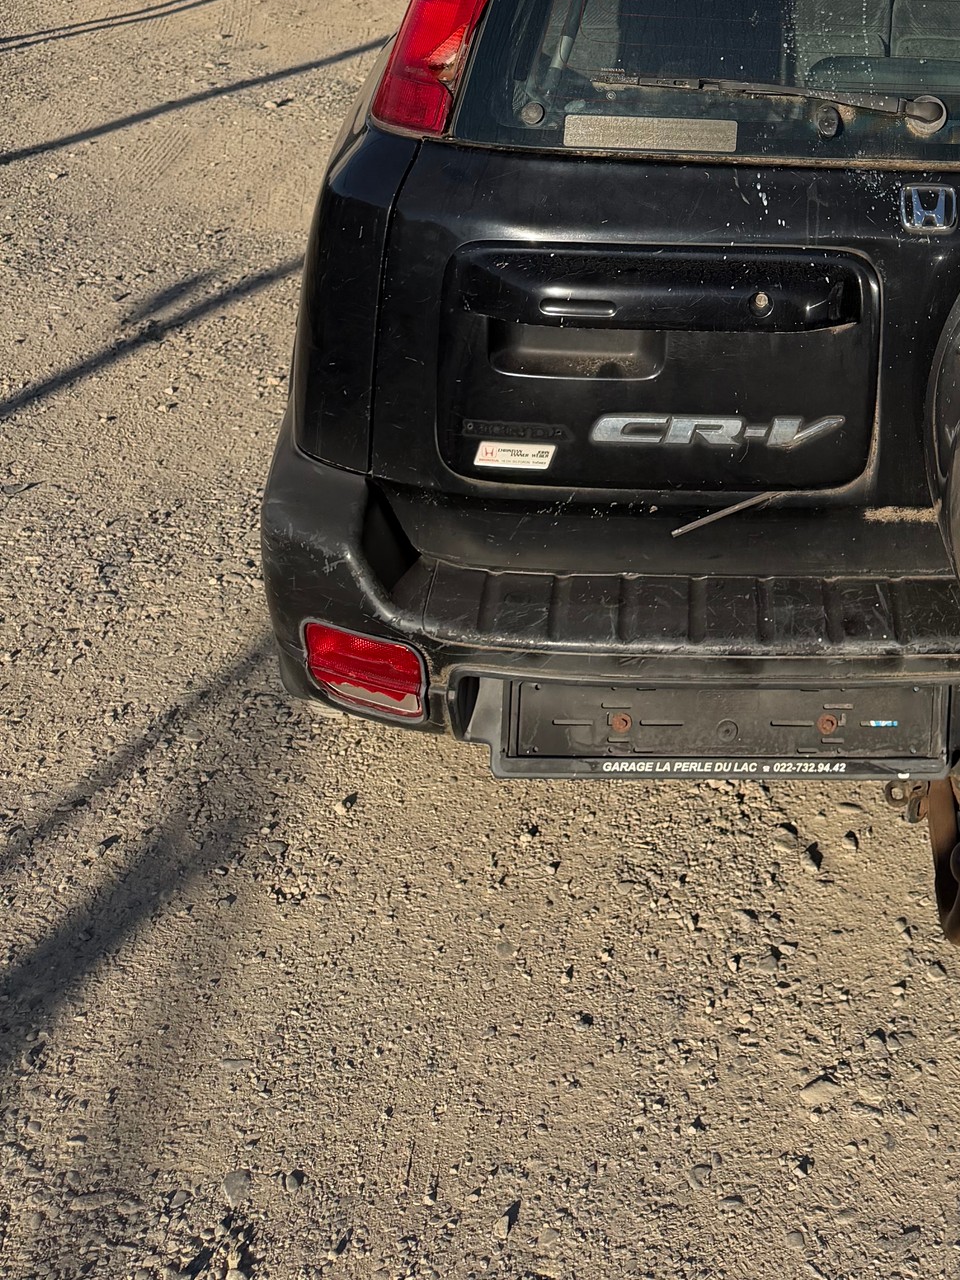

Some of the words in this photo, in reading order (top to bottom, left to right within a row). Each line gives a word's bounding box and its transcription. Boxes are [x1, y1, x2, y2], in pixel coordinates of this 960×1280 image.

[592, 416, 845, 449] CR-V
[602, 761, 653, 773] GARAGE
[655, 762, 671, 773] LA
[673, 762, 712, 773] PERLE
[714, 762, 731, 773] DU
[733, 762, 757, 773] LAC
[773, 762, 847, 774] 022-732.94.42
